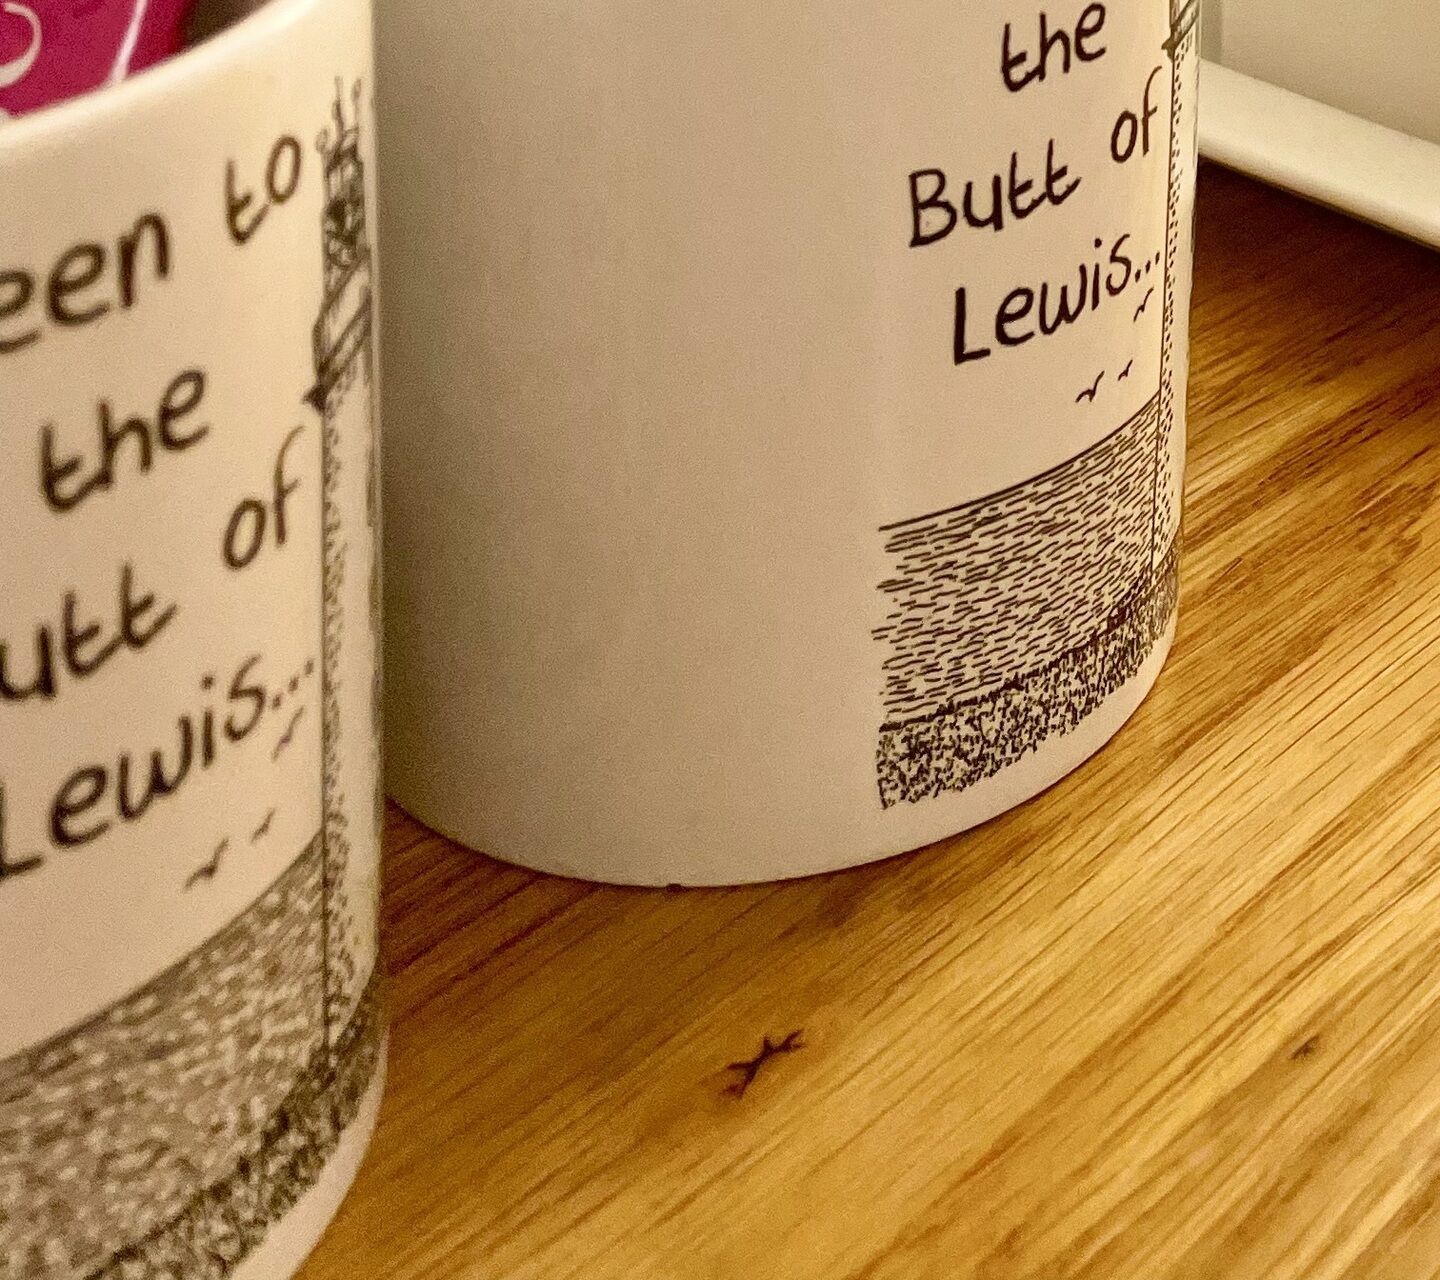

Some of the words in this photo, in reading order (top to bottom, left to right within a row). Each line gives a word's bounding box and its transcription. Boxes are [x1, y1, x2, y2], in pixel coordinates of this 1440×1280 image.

[1001, 2, 1107, 92] the
[225, 135, 302, 243] to
[908, 138, 1081, 248] Butt
[1110, 65, 1162, 164] of
[953, 233, 1161, 366] Lewis...
[40, 368, 210, 513] the
[221, 425, 306, 572] of
